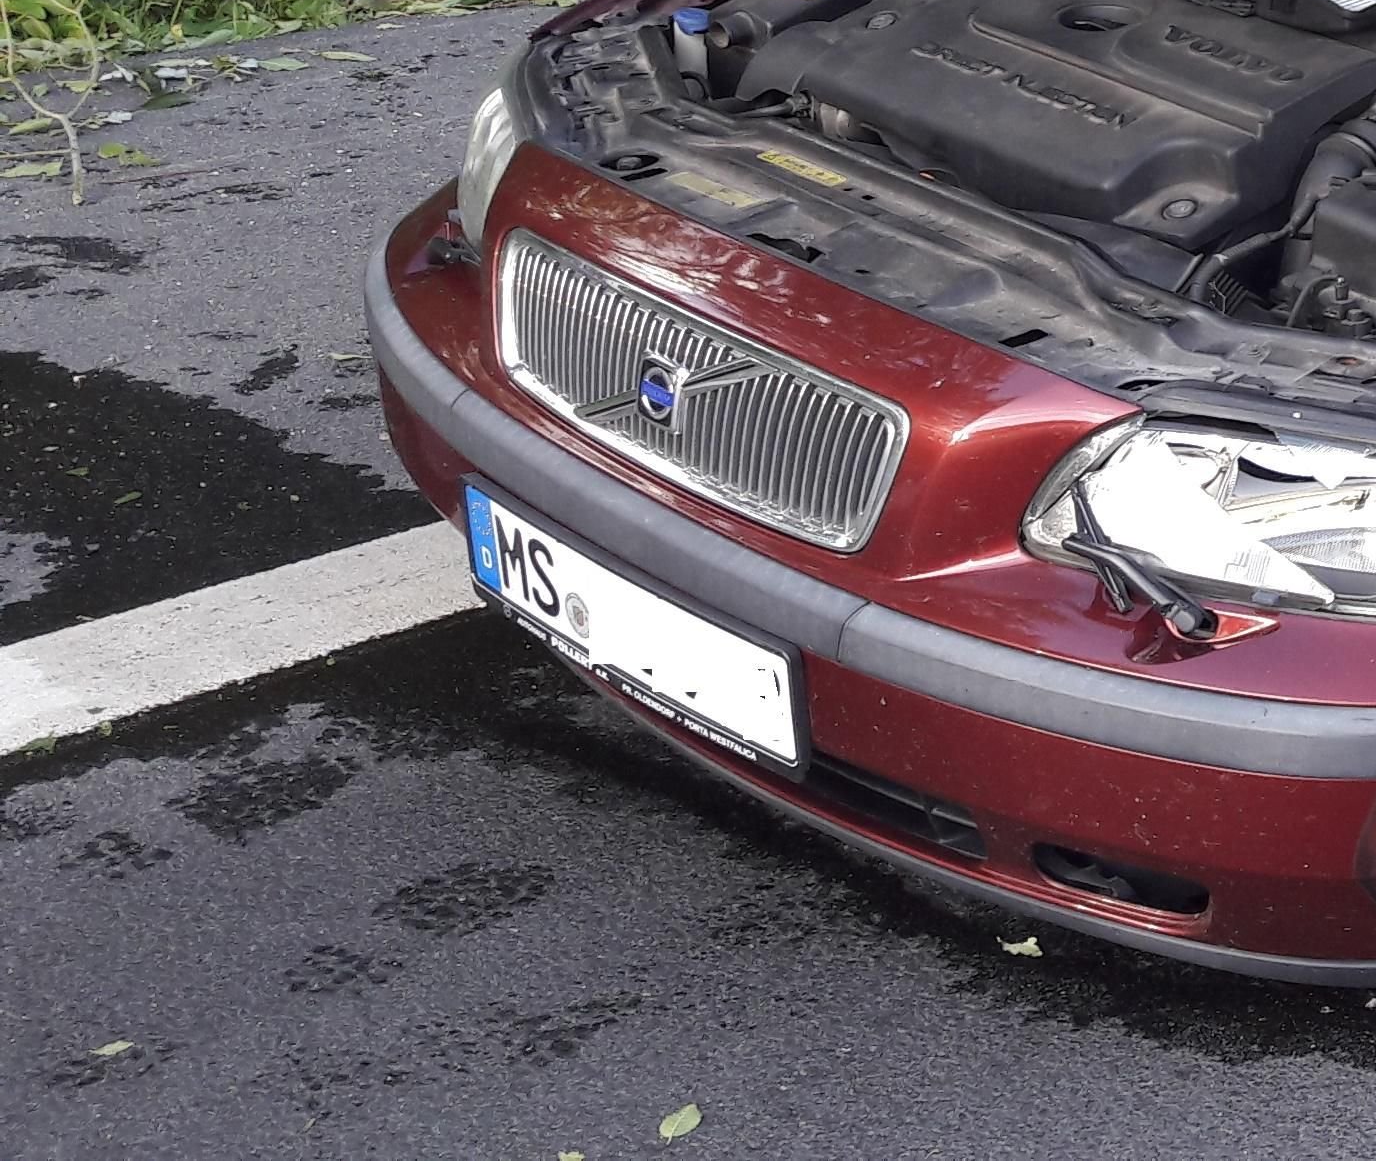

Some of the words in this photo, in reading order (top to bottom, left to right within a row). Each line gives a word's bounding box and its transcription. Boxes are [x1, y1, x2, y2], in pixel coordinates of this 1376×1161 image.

[1164, 25, 1305, 84] VOLVO
[481, 545, 493, 570] D
[494, 514, 560, 617] MS
[684, 717, 709, 738] PORTA
[709, 729, 758, 763] WESTFALICA
